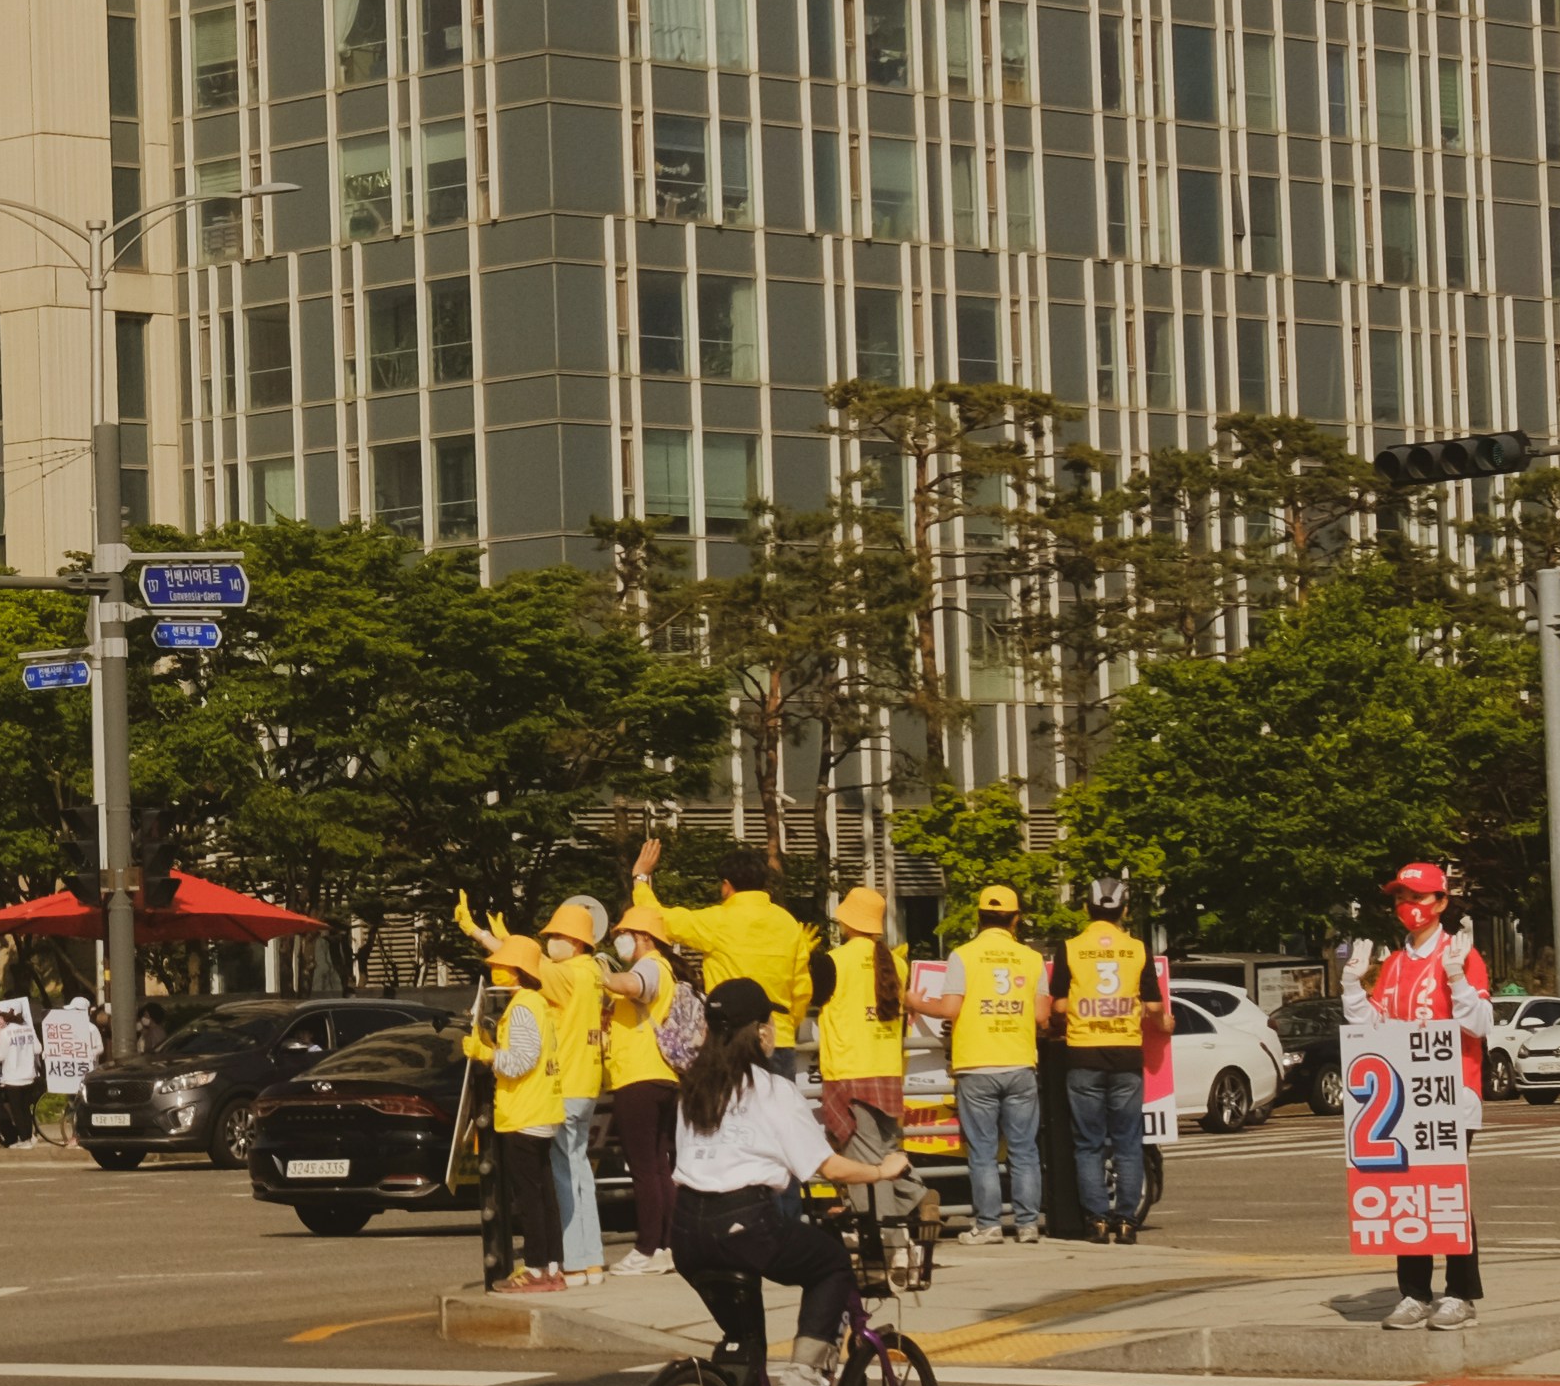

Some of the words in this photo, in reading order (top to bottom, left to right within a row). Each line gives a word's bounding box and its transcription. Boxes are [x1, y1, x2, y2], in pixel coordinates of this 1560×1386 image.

[147, 578, 160, 593] 137
[164, 568, 223, 589] 컨벤시아대로
[228, 577, 243, 593] 141
[1410, 908, 1427, 924] 2
[992, 967, 1011, 996] 3
[1096, 960, 1121, 997] 3
[980, 999, 1025, 1017] 조선희
[1409, 1030, 1454, 1063] 민생
[1410, 1078, 1457, 1108] 경제
[1346, 1052, 1409, 1173] 2
[1414, 1119, 1458, 1152] 회복
[1352, 1182, 1470, 1246] 유정복
